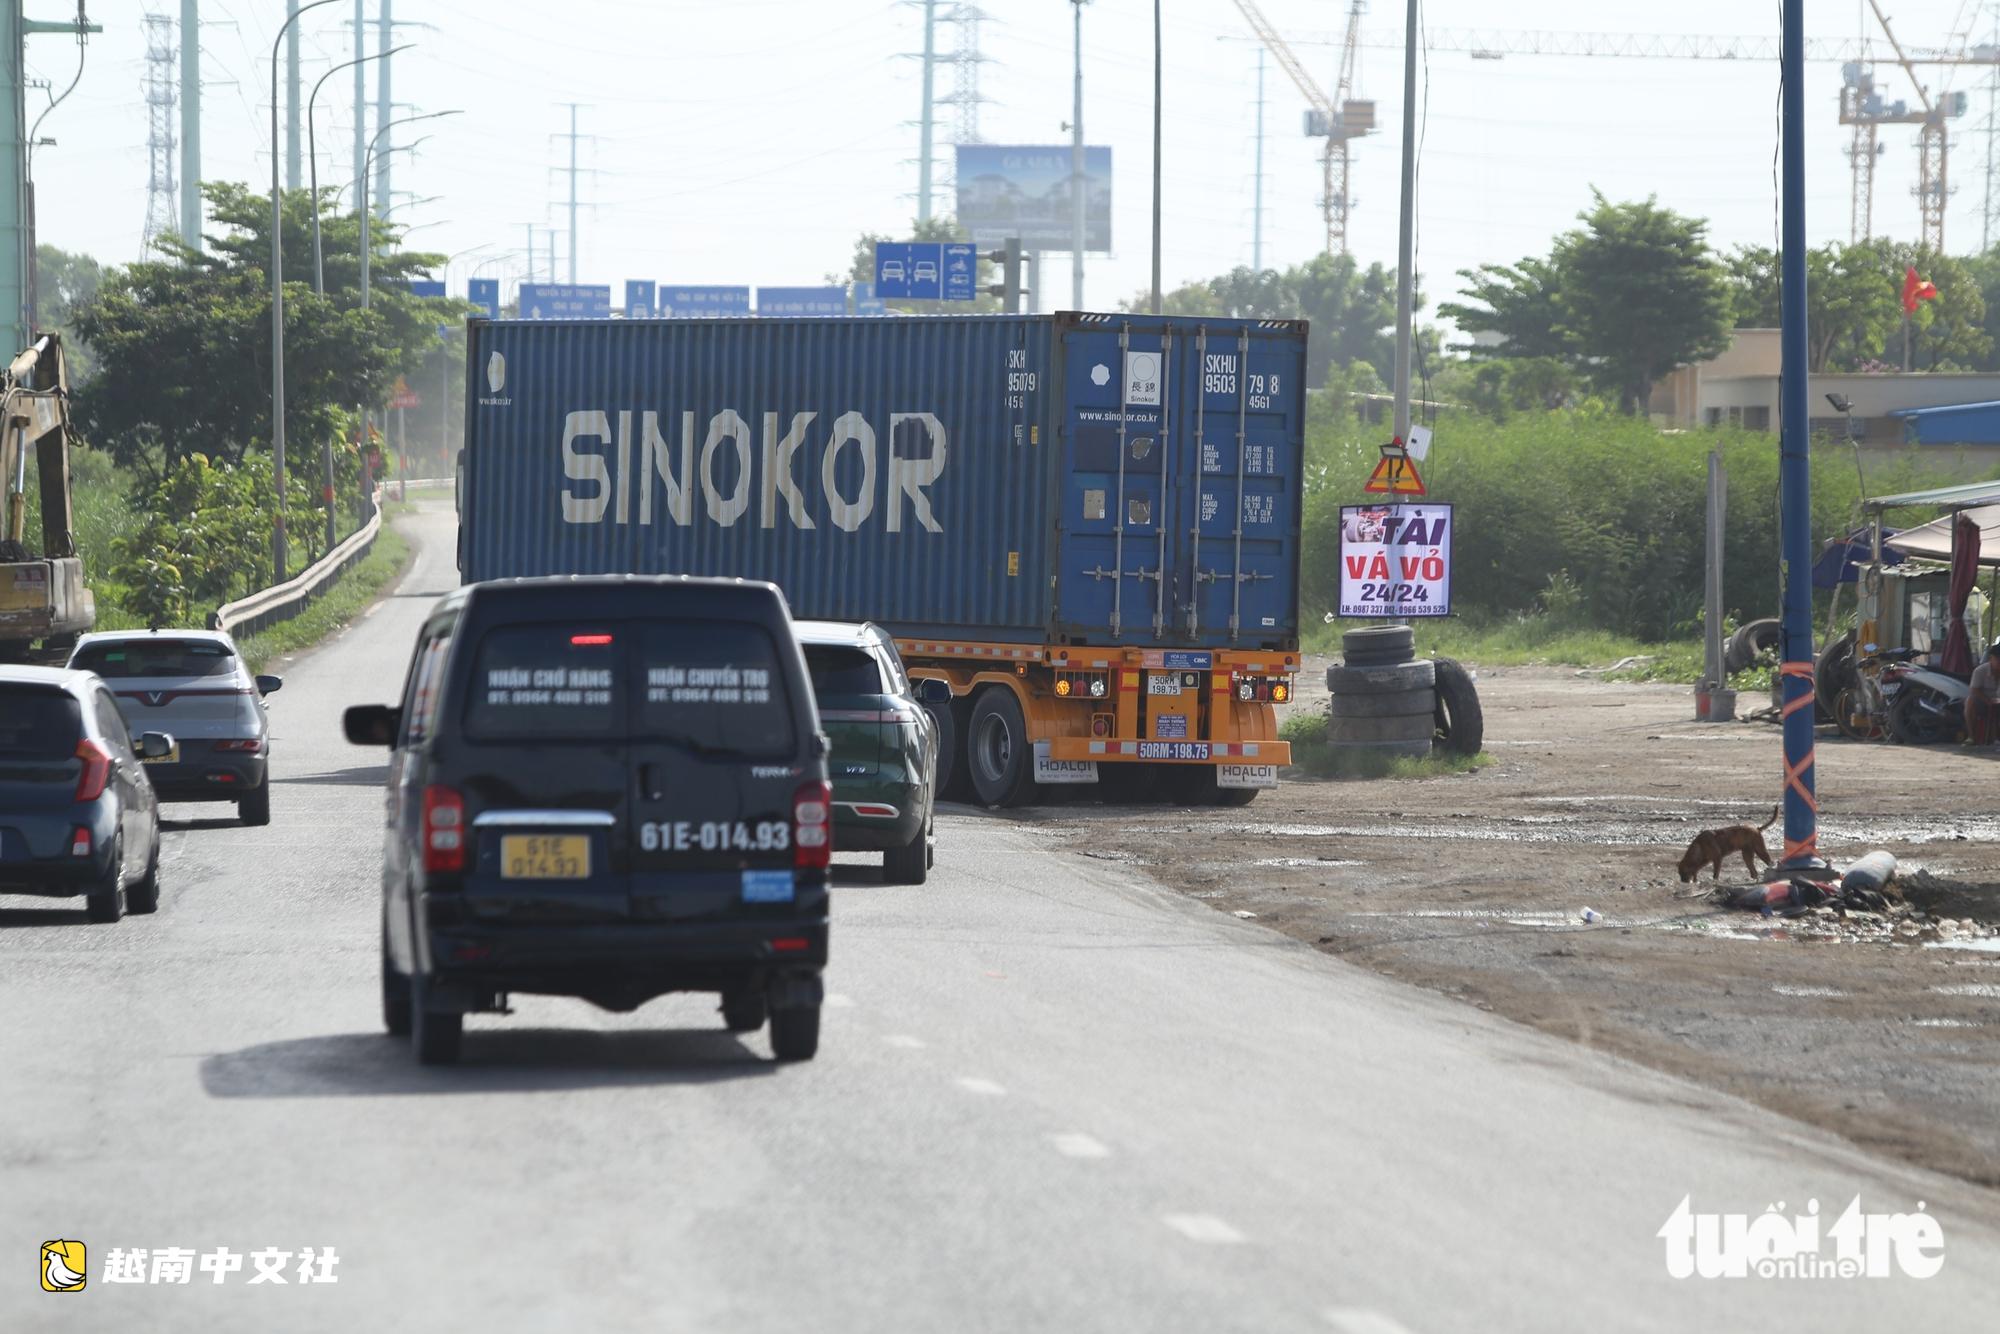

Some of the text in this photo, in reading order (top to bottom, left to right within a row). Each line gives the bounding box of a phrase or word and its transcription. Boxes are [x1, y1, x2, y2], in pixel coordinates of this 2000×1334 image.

[1205, 354, 1237, 374] SKHU
[1205, 374, 1236, 394] 9503
[1270, 375, 1279, 395] 8
[1249, 395, 1270, 409] 45G1
[1079, 412, 1157, 422] www.sinoor.co.kr
[561, 408, 947, 533] SINOKOR
[1381, 510, 1447, 546] TÀI
[1346, 549, 1444, 581] VÁ VỎ
[1360, 583, 1428, 602] 24/24
[1152, 686, 1178, 694] 198.75
[1139, 743, 1208, 760] 50RM-198.75
[641, 821, 790, 851] 61E-014.93
[526, 837, 564, 855] 61E
